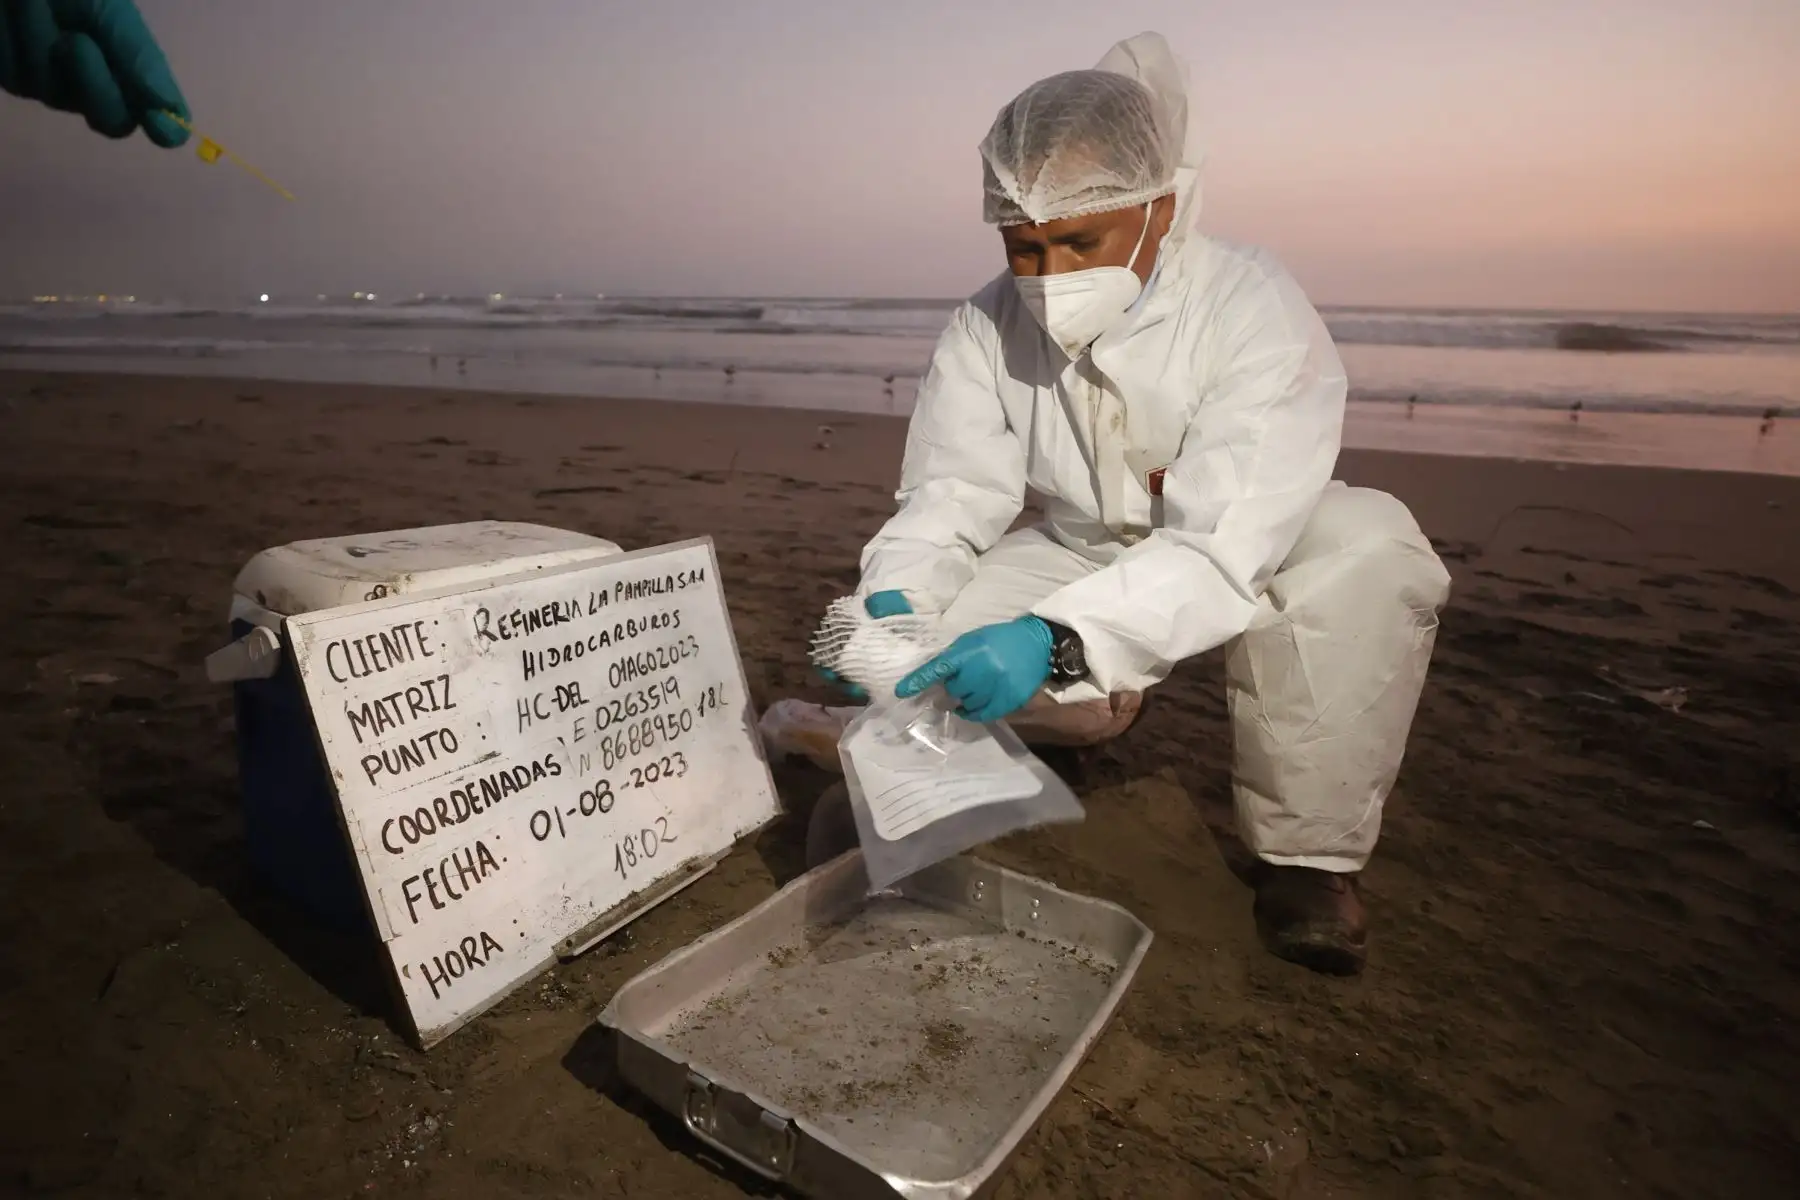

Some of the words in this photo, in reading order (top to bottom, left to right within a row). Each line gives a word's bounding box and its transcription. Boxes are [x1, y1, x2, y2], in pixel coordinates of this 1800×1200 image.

[326, 619, 446, 683] CLIENTE:
[473, 599, 582, 642] REFINERIA
[588, 590, 608, 615] LA
[614, 575, 674, 602] PAMPILLA
[347, 674, 456, 743] MATRIZ
[522, 609, 681, 681] HIDROCARBUROS
[580, 752, 591, 778] N
[601, 708, 692, 771] 8688950
[614, 816, 677, 880] 18:02
